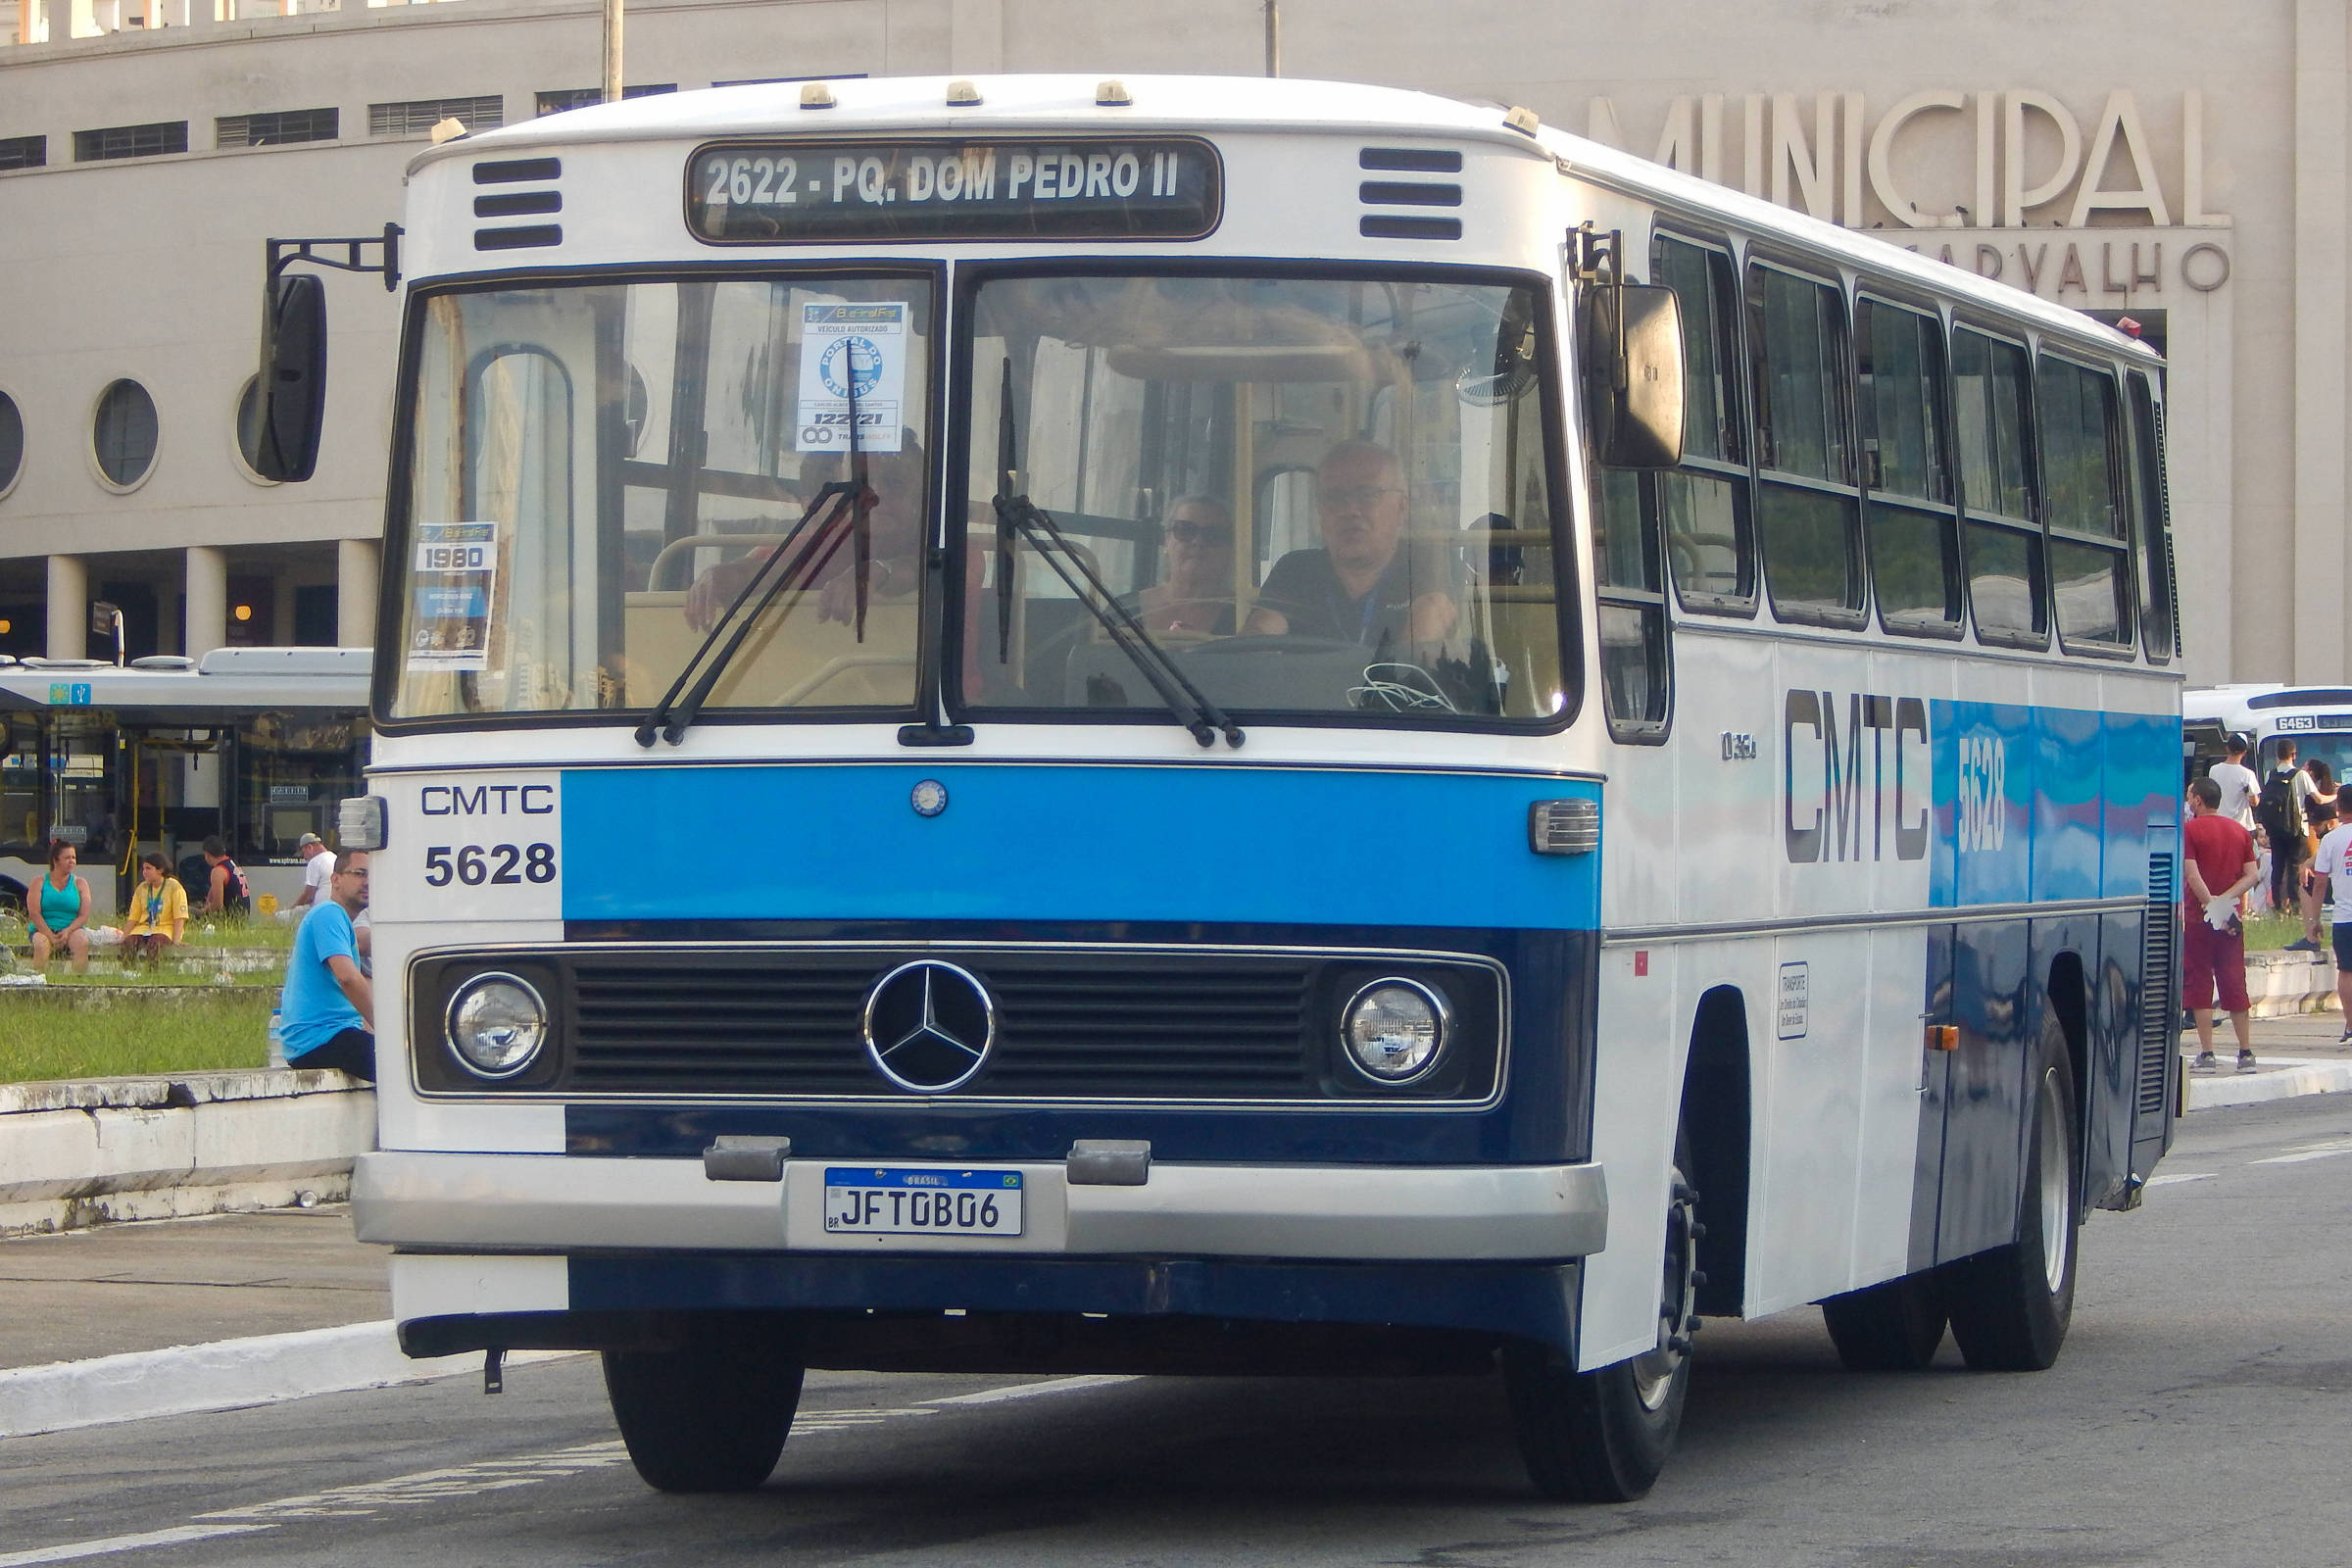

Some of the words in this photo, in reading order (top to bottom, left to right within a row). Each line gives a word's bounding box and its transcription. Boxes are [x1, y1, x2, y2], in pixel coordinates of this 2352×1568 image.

[706, 157, 797, 205] 2622
[833, 156, 897, 206] PQ.
[908, 154, 997, 202] DOM
[1008, 152, 1140, 199] PEDRO
[1152, 152, 1178, 197] II
[1905, 242, 2230, 292] RVALHO
[821, 337, 866, 366] PORTAL
[868, 347, 881, 365] DO
[823, 377, 877, 398] ONIUS
[425, 548, 483, 568] 1980
[2278, 716, 2313, 730] 6463
[1785, 688, 1928, 863] CMTC
[1958, 736, 2005, 854] 5628
[421, 785, 554, 815] CMTC
[424, 842, 557, 887] 5628
[828, 1217, 839, 1228] BR
